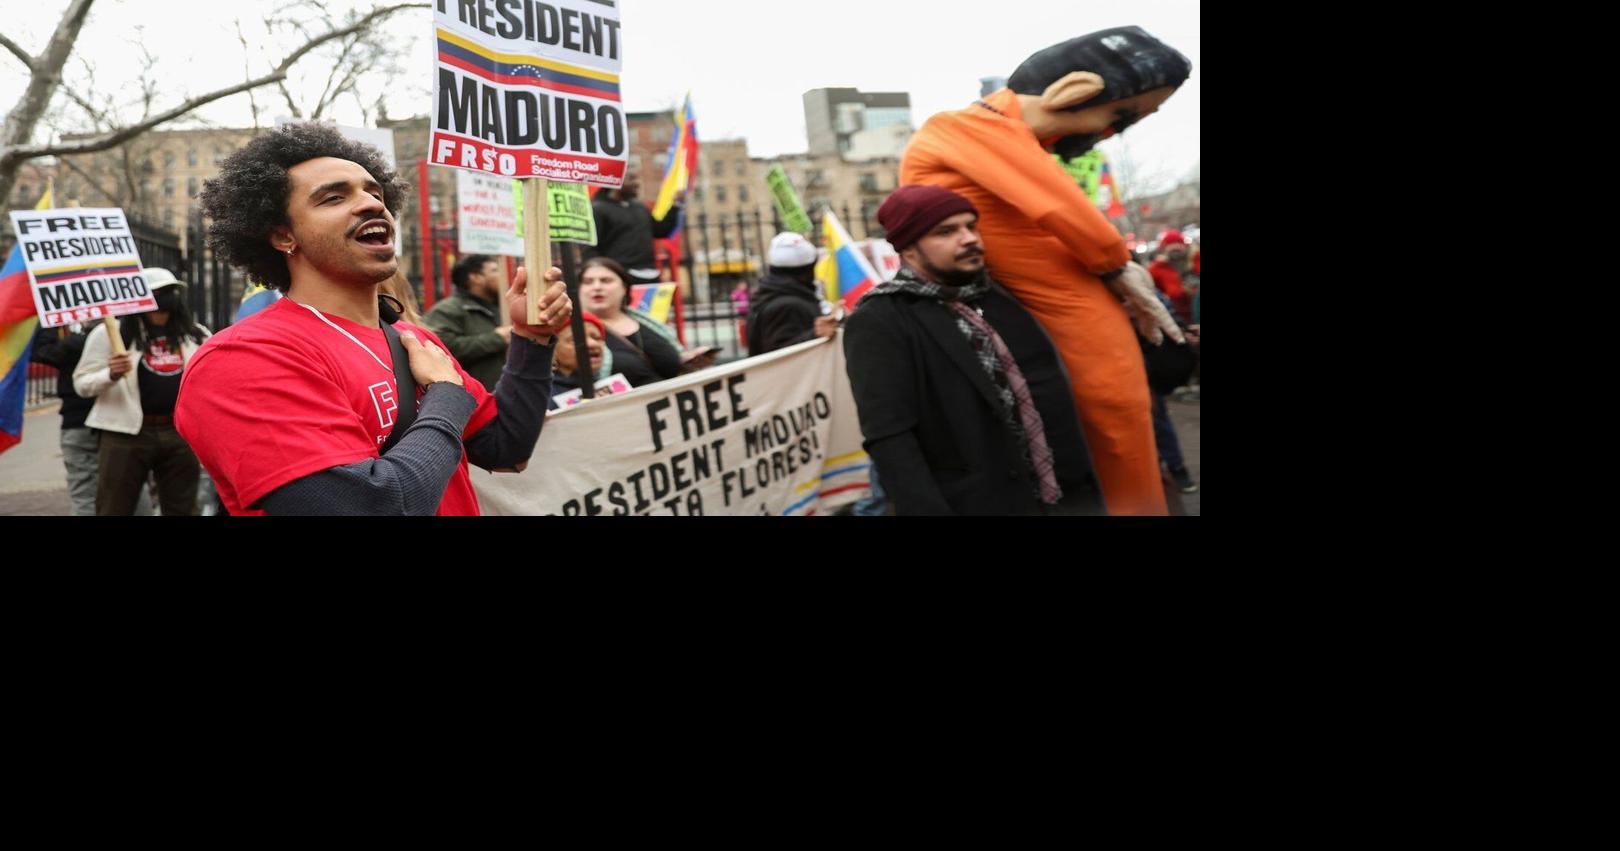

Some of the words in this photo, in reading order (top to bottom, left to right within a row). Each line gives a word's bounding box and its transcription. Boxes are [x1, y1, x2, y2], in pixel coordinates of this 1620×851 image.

[438, 67, 624, 156] MADURO
[437, 138, 516, 176] FRSO
[531, 154, 573, 170] Freedom
[573, 160, 600, 172] Road
[532, 165, 571, 179] Socialist
[571, 169, 622, 186] Organization
[18, 216, 124, 235] FREE
[25, 236, 133, 262] PRESIDENT
[38, 276, 148, 311] MADURO
[646, 373, 750, 453] FREE
[545, 438, 725, 516] RESIDENT
[744, 391, 831, 459] MADURO
[722, 430, 822, 507] FLORES!
